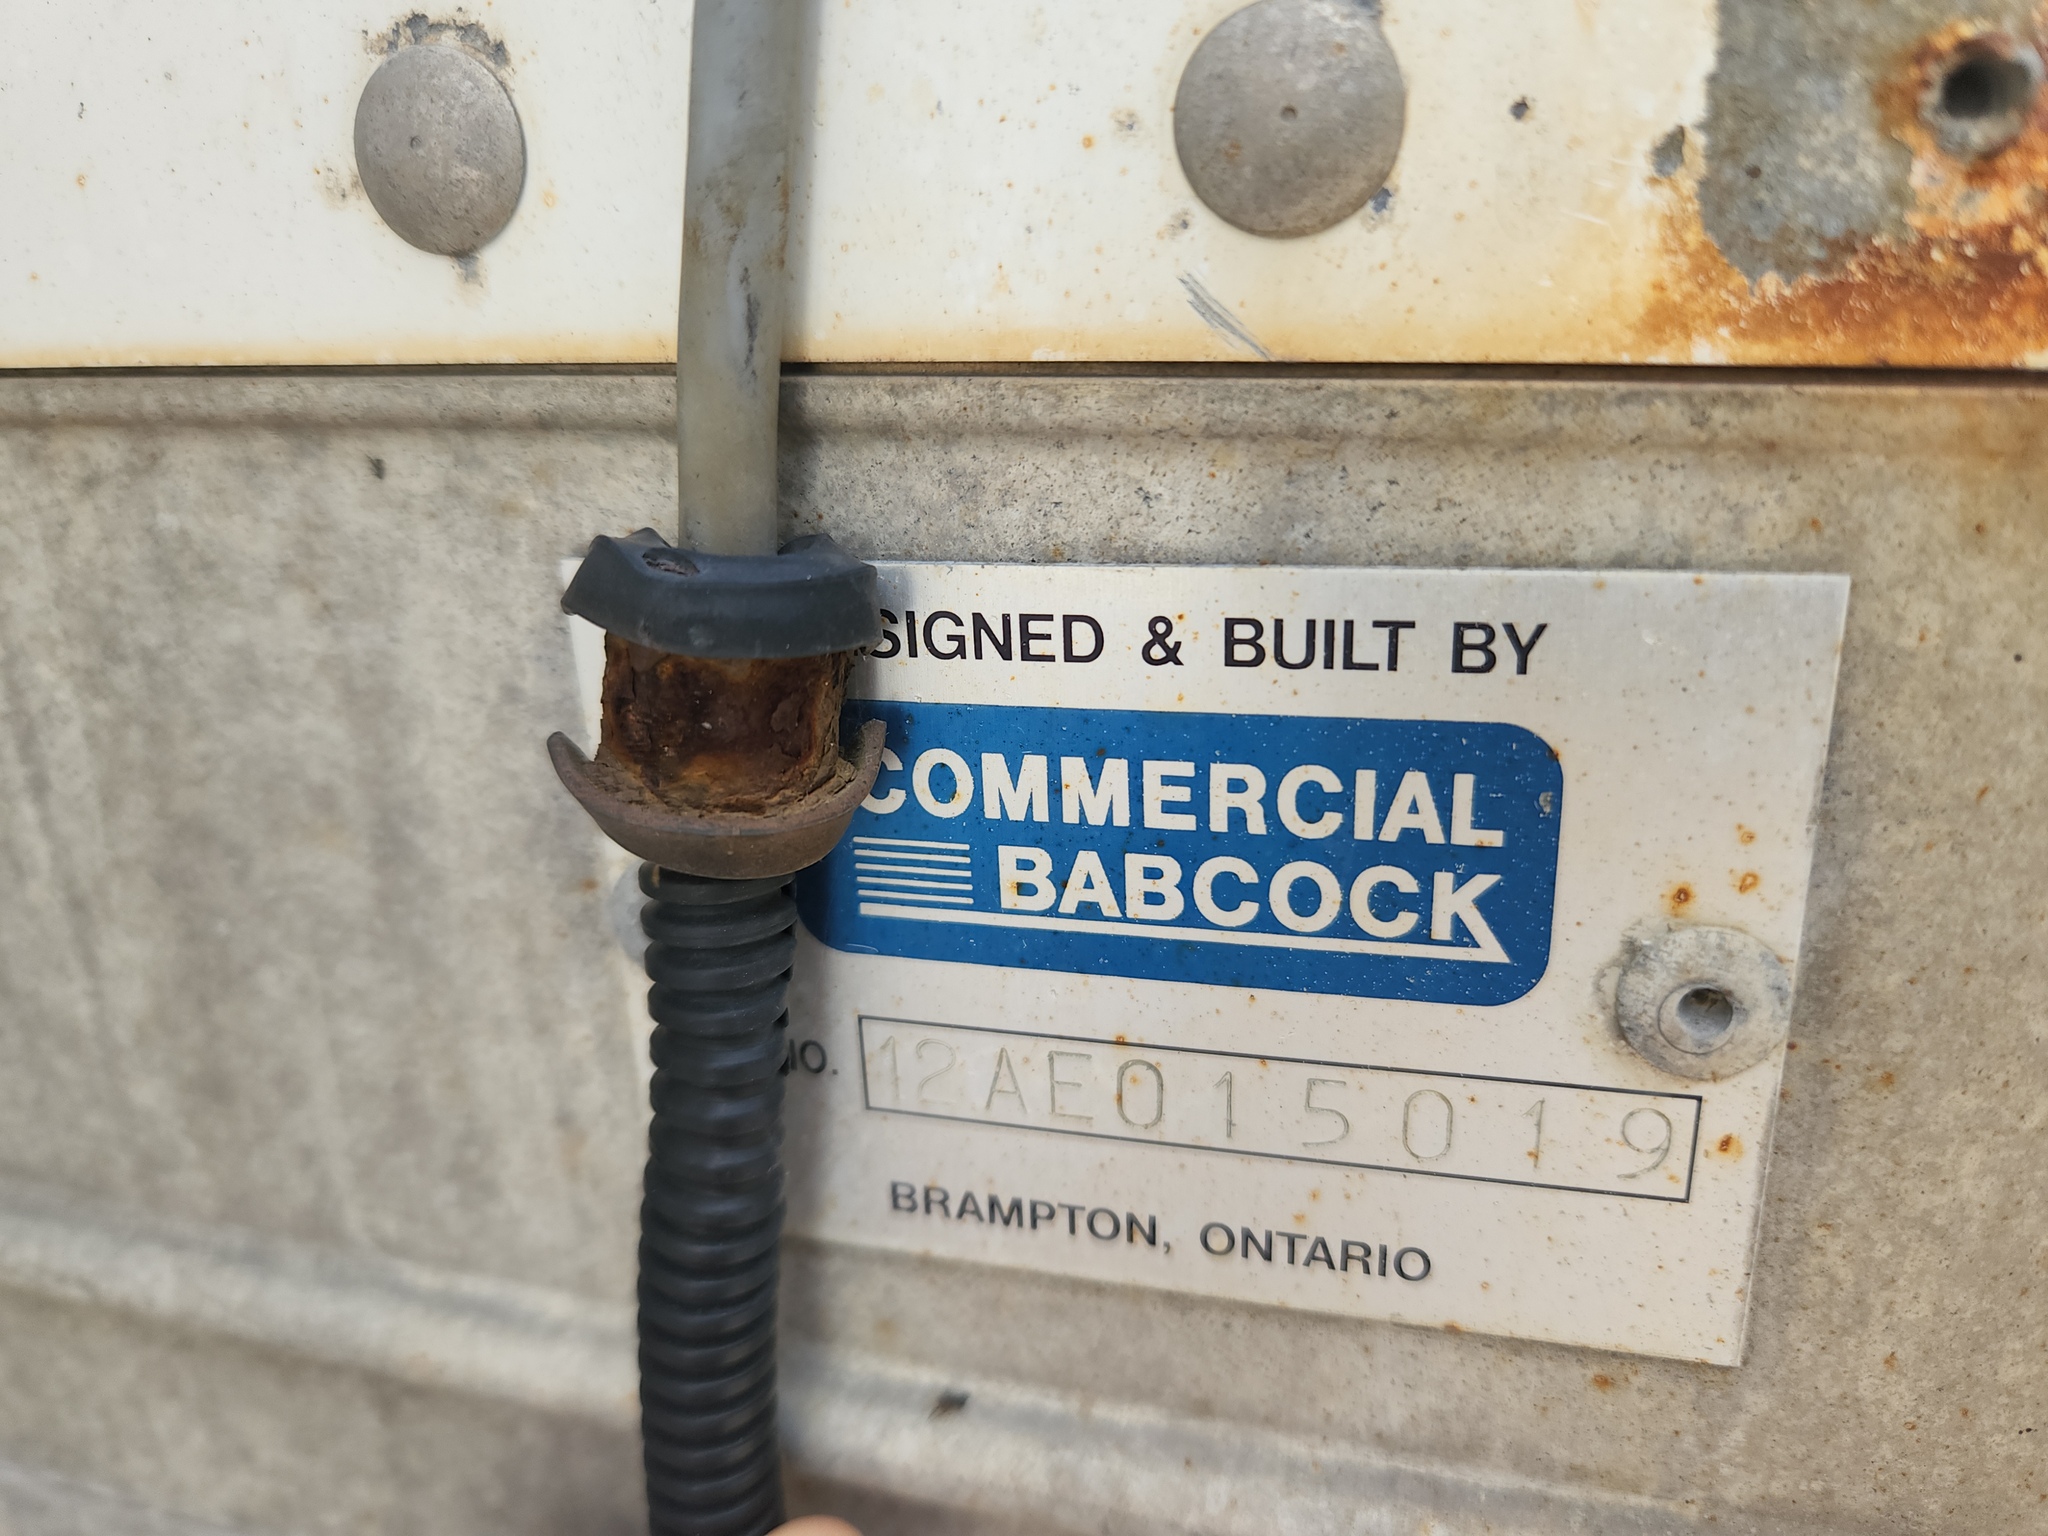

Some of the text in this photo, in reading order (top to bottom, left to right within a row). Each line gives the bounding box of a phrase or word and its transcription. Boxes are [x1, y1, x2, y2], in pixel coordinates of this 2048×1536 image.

[854, 607, 1547, 675] SIGNED & BUILT BY
[860, 747, 1506, 847] COMMERCIAL
[996, 844, 1511, 963] BABCOCK
[889, 1180, 1431, 1282] BRAMPTON, ONTARIO
